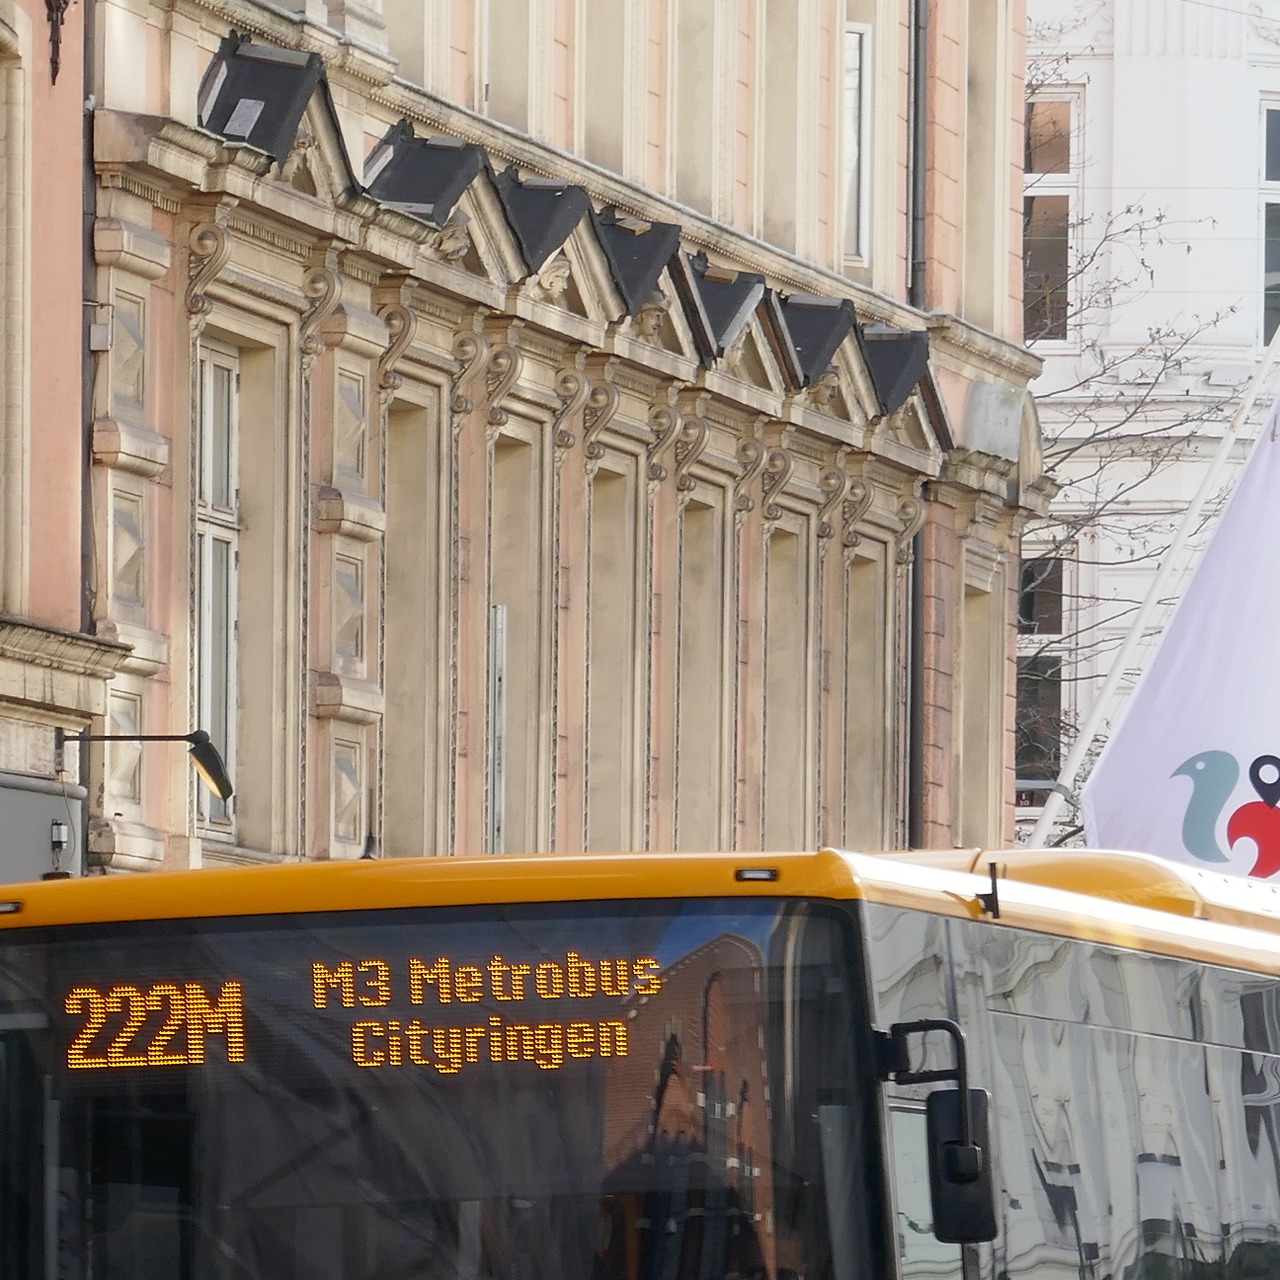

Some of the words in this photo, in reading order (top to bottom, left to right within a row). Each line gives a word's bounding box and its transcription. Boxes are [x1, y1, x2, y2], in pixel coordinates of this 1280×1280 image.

[312, 960, 391, 1009] M3
[408, 952, 662, 1005] Metrobus
[65, 982, 245, 1069] 222M
[351, 1016, 628, 1074] Cityringen
